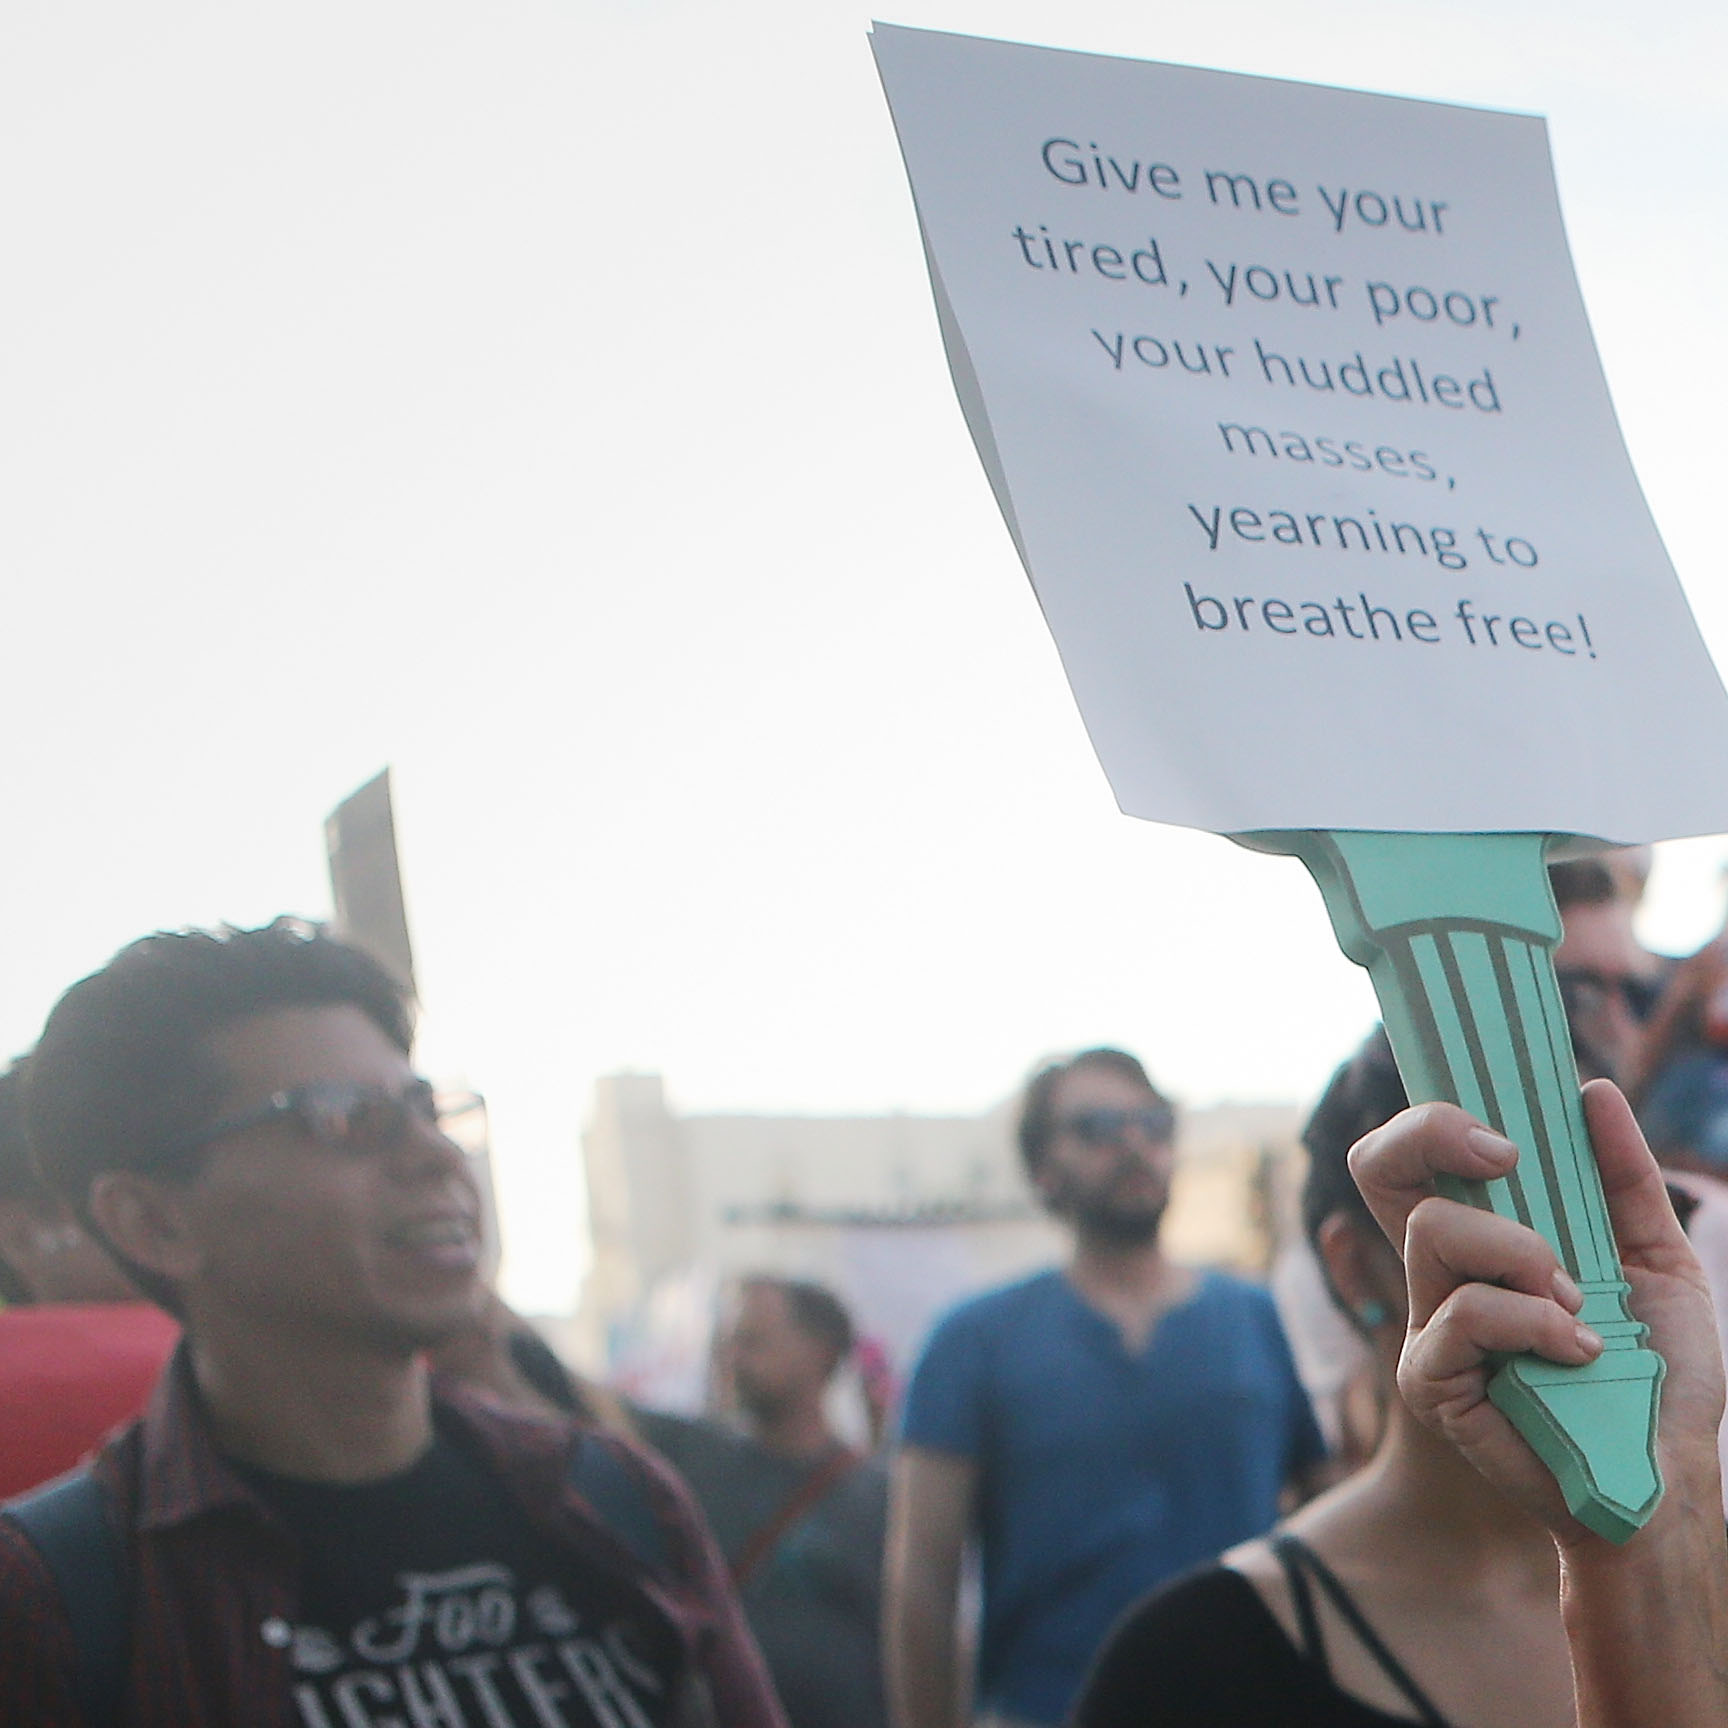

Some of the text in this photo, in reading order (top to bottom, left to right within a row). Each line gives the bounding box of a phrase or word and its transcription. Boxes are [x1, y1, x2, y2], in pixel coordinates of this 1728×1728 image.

[1040, 137, 1449, 236] Give me your
[1011, 224, 1522, 342] tired, your poor,
[1090, 328, 1504, 414] your huddled
[1217, 422, 1457, 492] masses,
[1186, 502, 1540, 571] yearning to
[1183, 581, 1598, 660] breathe free!
[348, 1561, 518, 1664] Foo
